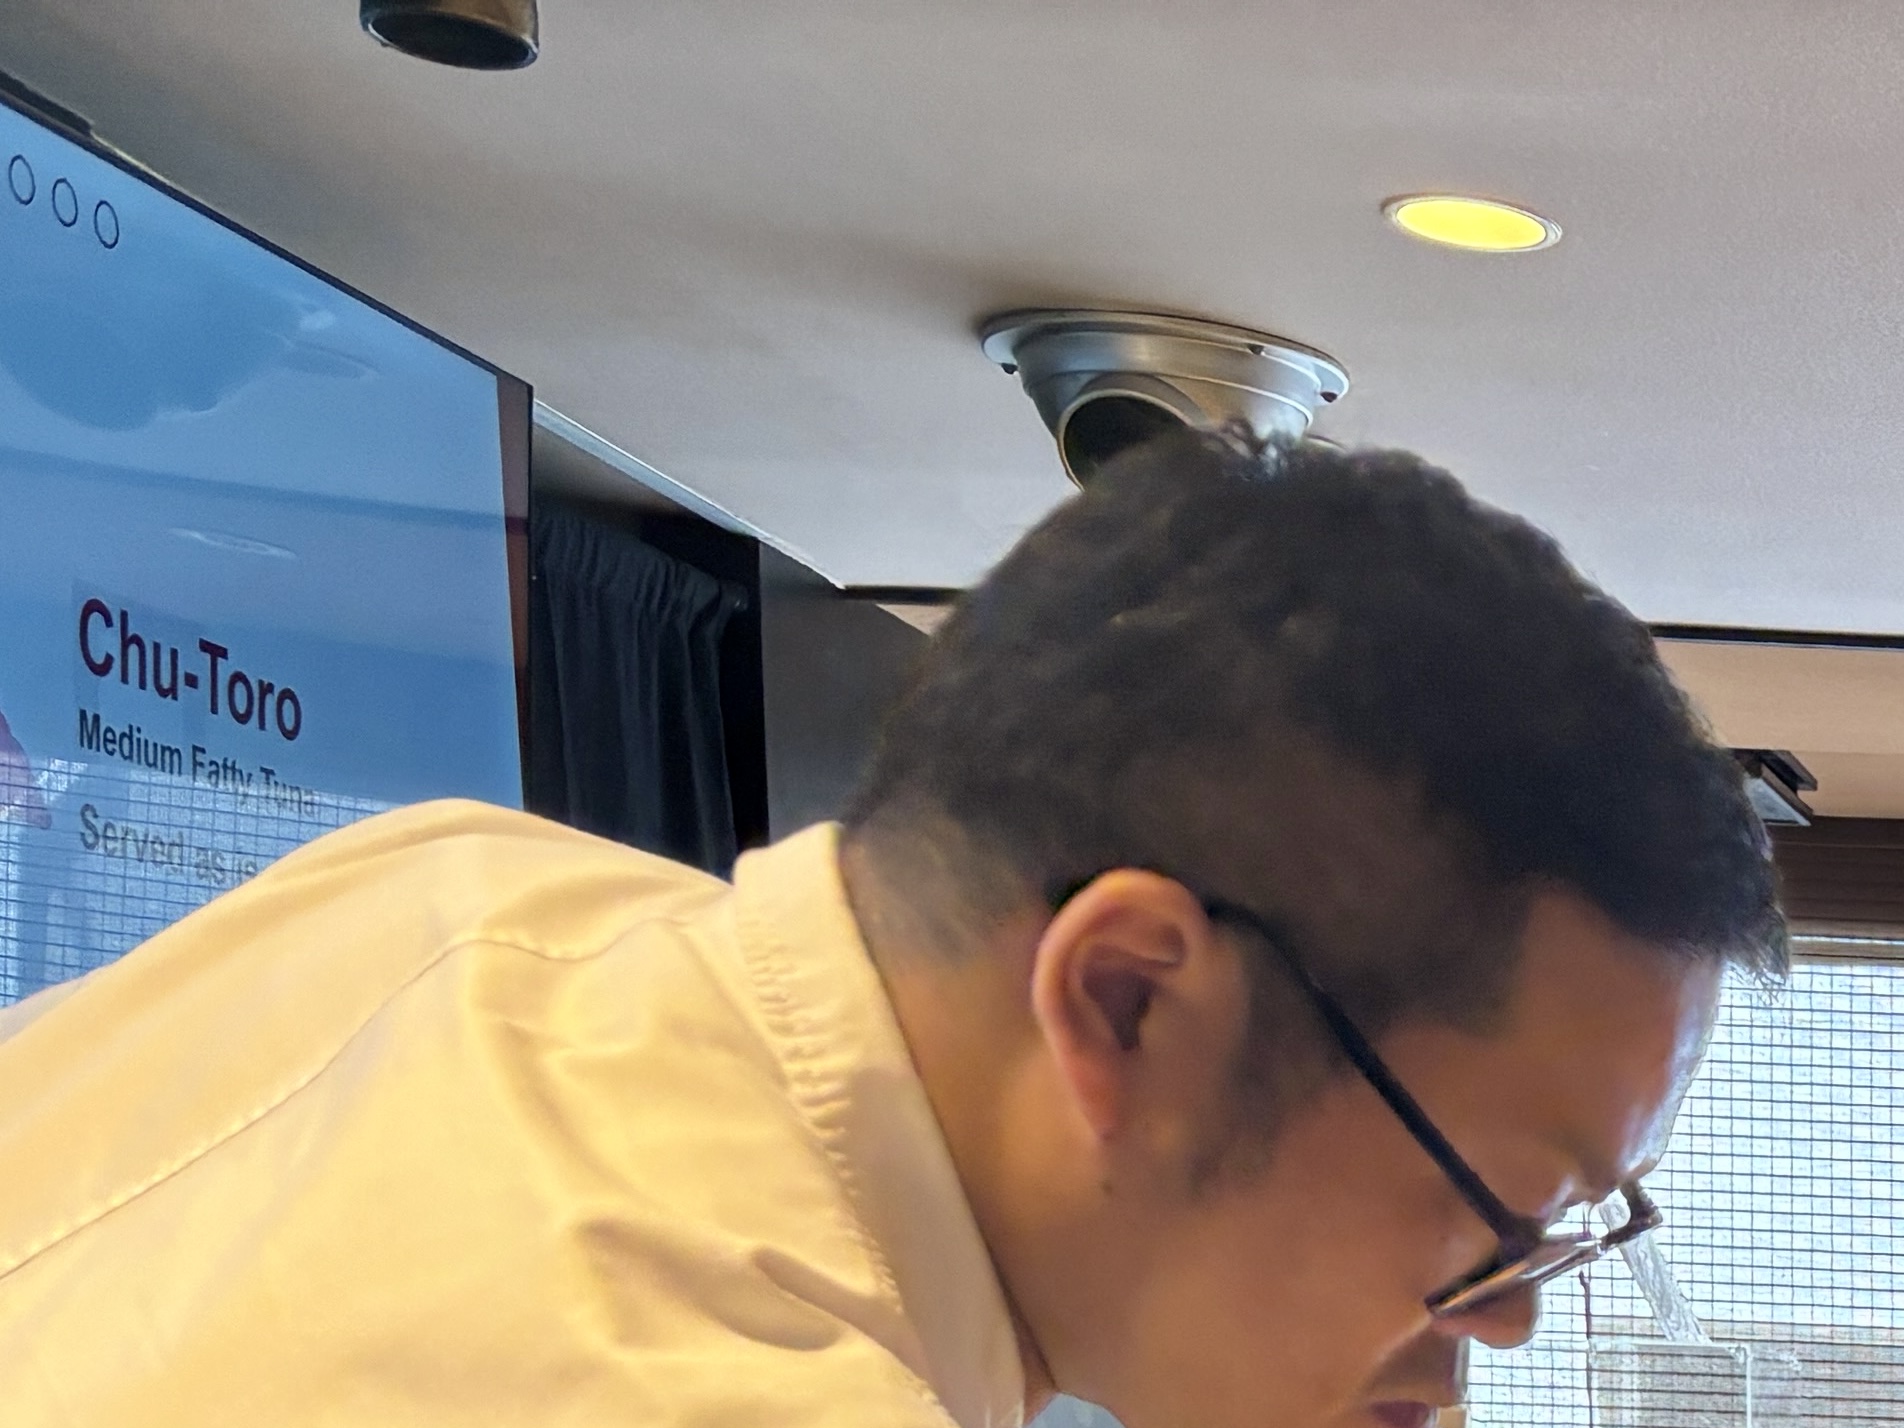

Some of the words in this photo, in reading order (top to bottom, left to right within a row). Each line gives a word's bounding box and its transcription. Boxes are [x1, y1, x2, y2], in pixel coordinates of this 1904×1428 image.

[79, 598, 302, 741] Chu-Toro
[79, 708, 183, 777] Medium
[192, 744, 253, 805] Fatty
[259, 766, 320, 818] Tuna
[80, 803, 185, 876] Served
